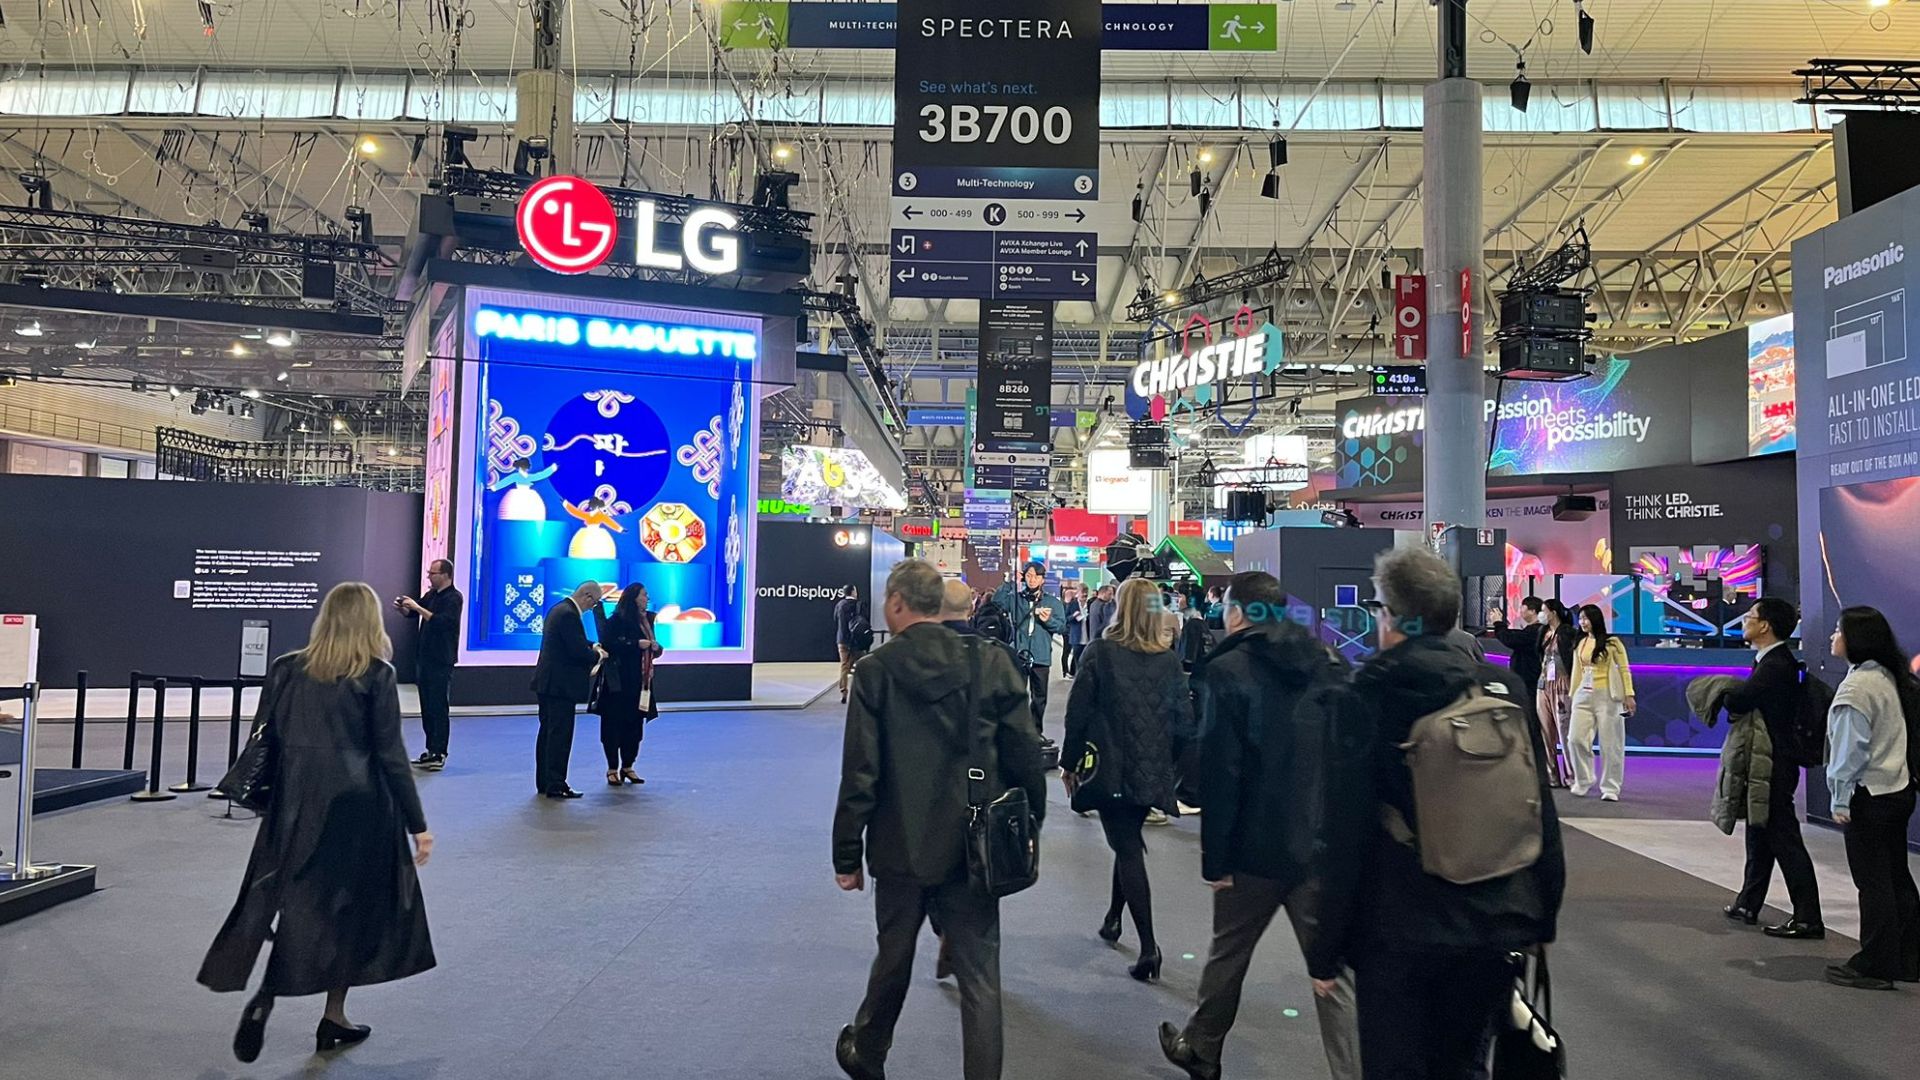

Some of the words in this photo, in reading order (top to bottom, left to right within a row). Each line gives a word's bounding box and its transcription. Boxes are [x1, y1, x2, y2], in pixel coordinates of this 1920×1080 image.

[921, 18, 1072, 38] SPECTERA
[919, 80, 946, 94] See
[951, 81, 998, 95] what's
[1002, 83, 1038, 95] next.
[919, 104, 1072, 144] 3B700
[904, 176, 911, 186] 3
[957, 178, 1035, 190] Multi-Technology
[1080, 179, 1087, 190] 3
[990, 206, 1000, 222] K
[636, 200, 738, 274] LG
[1824, 242, 1904, 289] Panasonic
[475, 309, 579, 345] PARIS
[586, 320, 756, 359] BAGUETTE
[1133, 332, 1265, 398] CHRISTIE
[999, 385, 1029, 393] 8B260
[1828, 382, 1895, 418] ALL-IN-ONE
[1484, 394, 1552, 421] Passion
[1526, 406, 1586, 432] meets
[1548, 411, 1650, 450] possibility
[1829, 421, 1853, 445] FAST
[1856, 418, 1869, 440] TO
[1830, 462, 1850, 476] READY
[1850, 460, 1863, 474] OUT
[1864, 458, 1872, 472] OF
[1874, 456, 1887, 470] THE
[1888, 454, 1902, 468] BOX
[1903, 452, 1918, 466] AND
[1626, 495, 1662, 507] THINK
[1666, 493, 1692, 506] LED.
[1505, 507, 1520, 516] THE
[1626, 507, 1662, 520] THINK
[1666, 504, 1724, 518] CHRISTIE.
[788, 585, 845, 600] Displays
